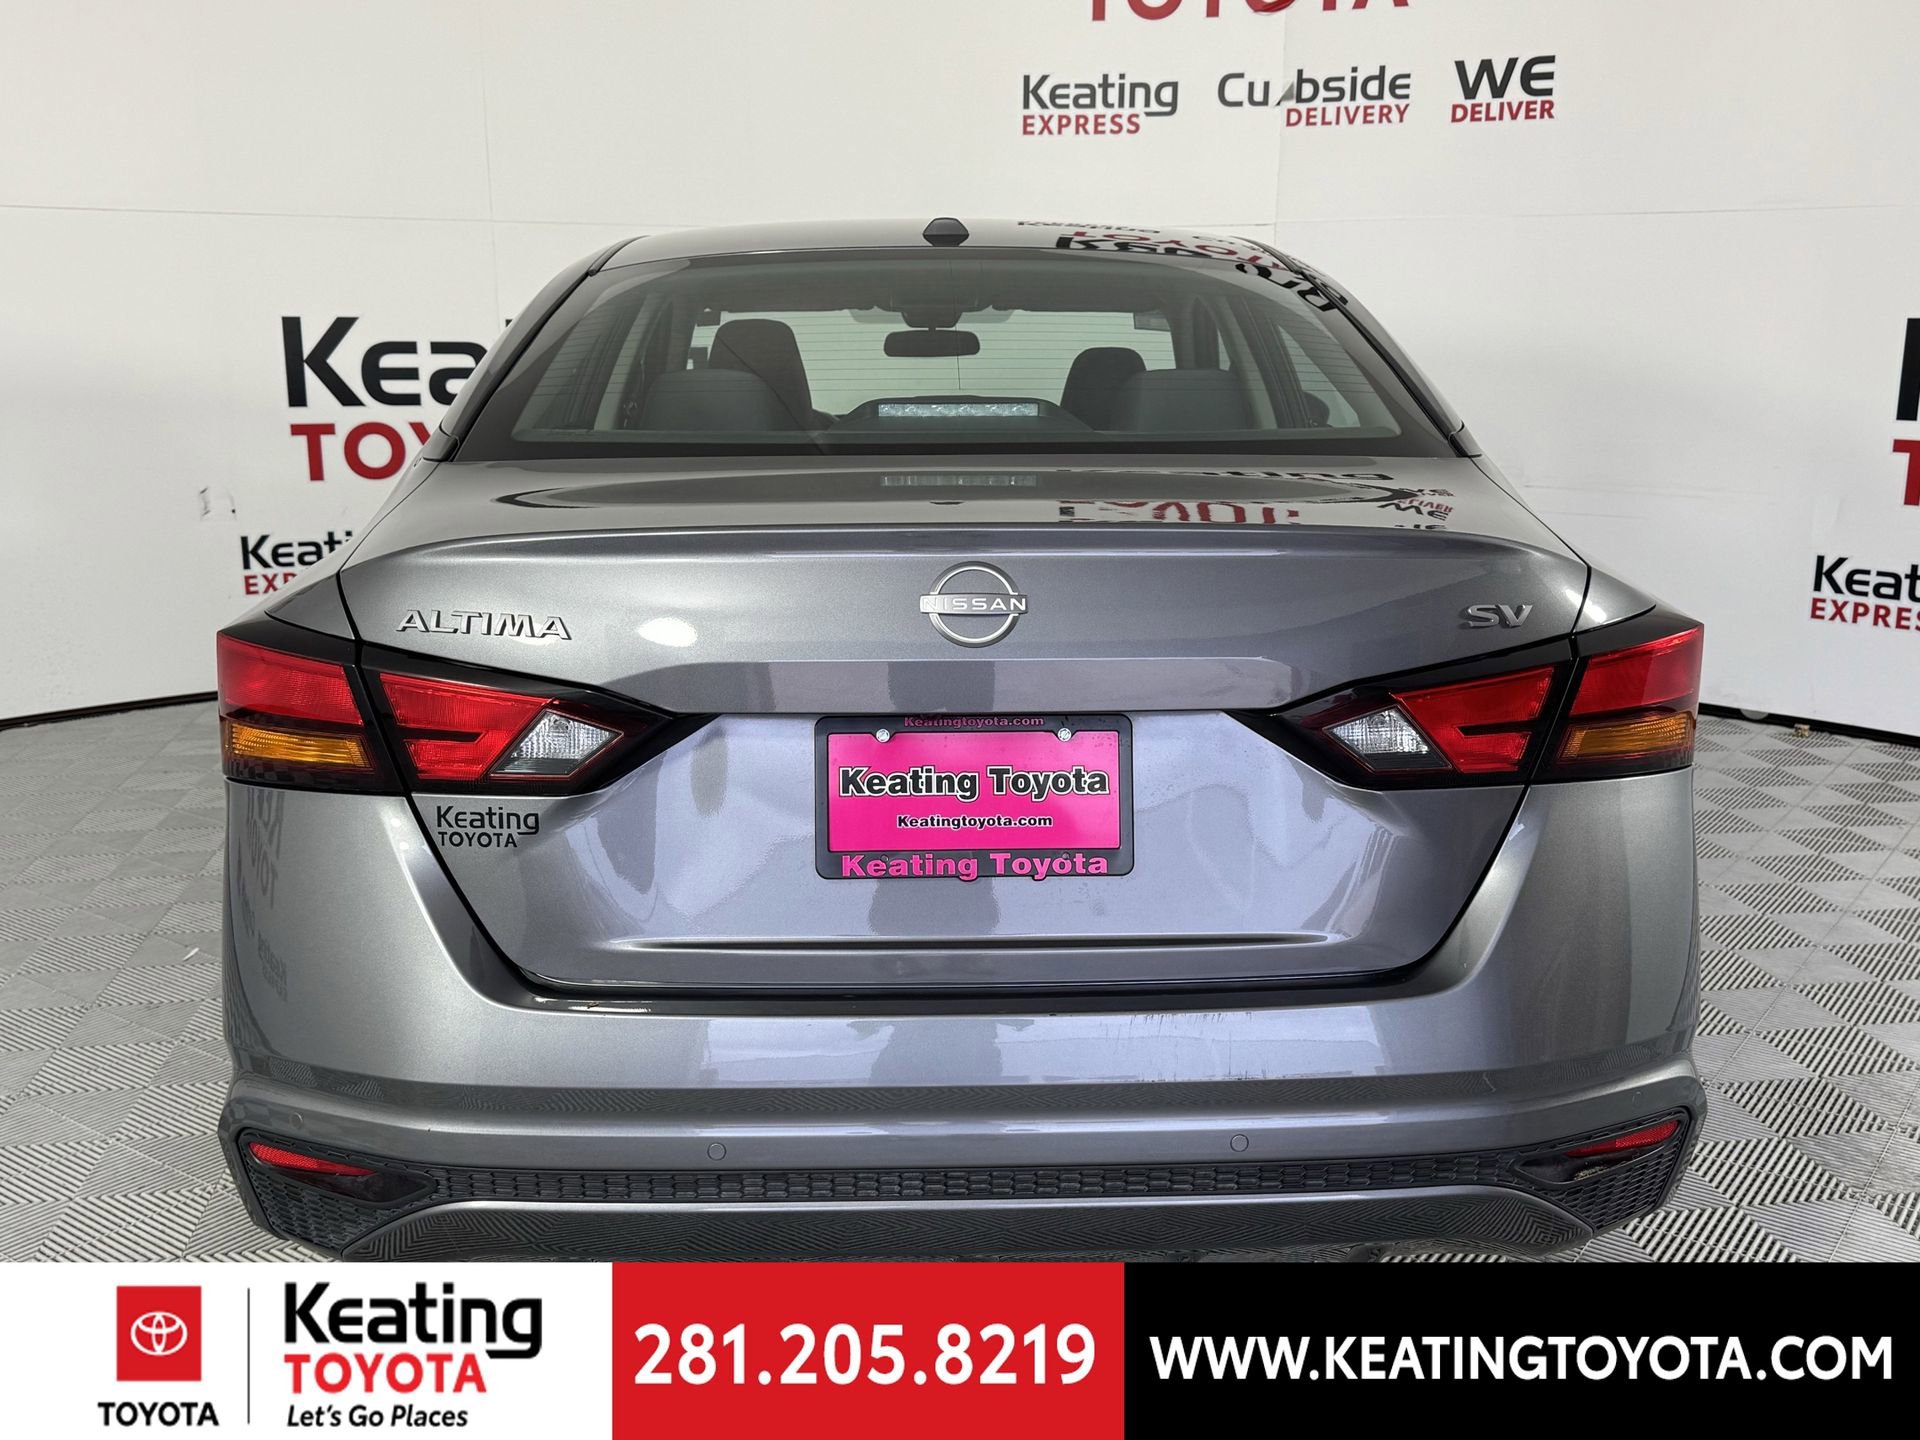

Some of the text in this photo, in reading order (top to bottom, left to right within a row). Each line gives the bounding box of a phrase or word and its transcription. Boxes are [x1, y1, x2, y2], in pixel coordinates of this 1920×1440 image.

[1217, 65, 1411, 107] Cubside
[1454, 54, 1556, 101] WE
[1023, 73, 1179, 117] Keating
[1285, 104, 1410, 128] DELIVERY
[1450, 100, 1554, 123] DELIVER
[1022, 113, 1141, 136] EXPRESS
[922, 597, 1026, 611] NISSAN
[1462, 604, 1533, 629] SV
[396, 609, 572, 641] ALTIMA
[903, 716, 1044, 728] Keatingtoyota.com
[839, 766, 1110, 802] Keating Toyota
[436, 805, 540, 835] Keating
[897, 814, 1053, 829] Keatingtoyota.com
[438, 831, 518, 848] TOYOTA
[841, 853, 1109, 881] Keating Toyota
